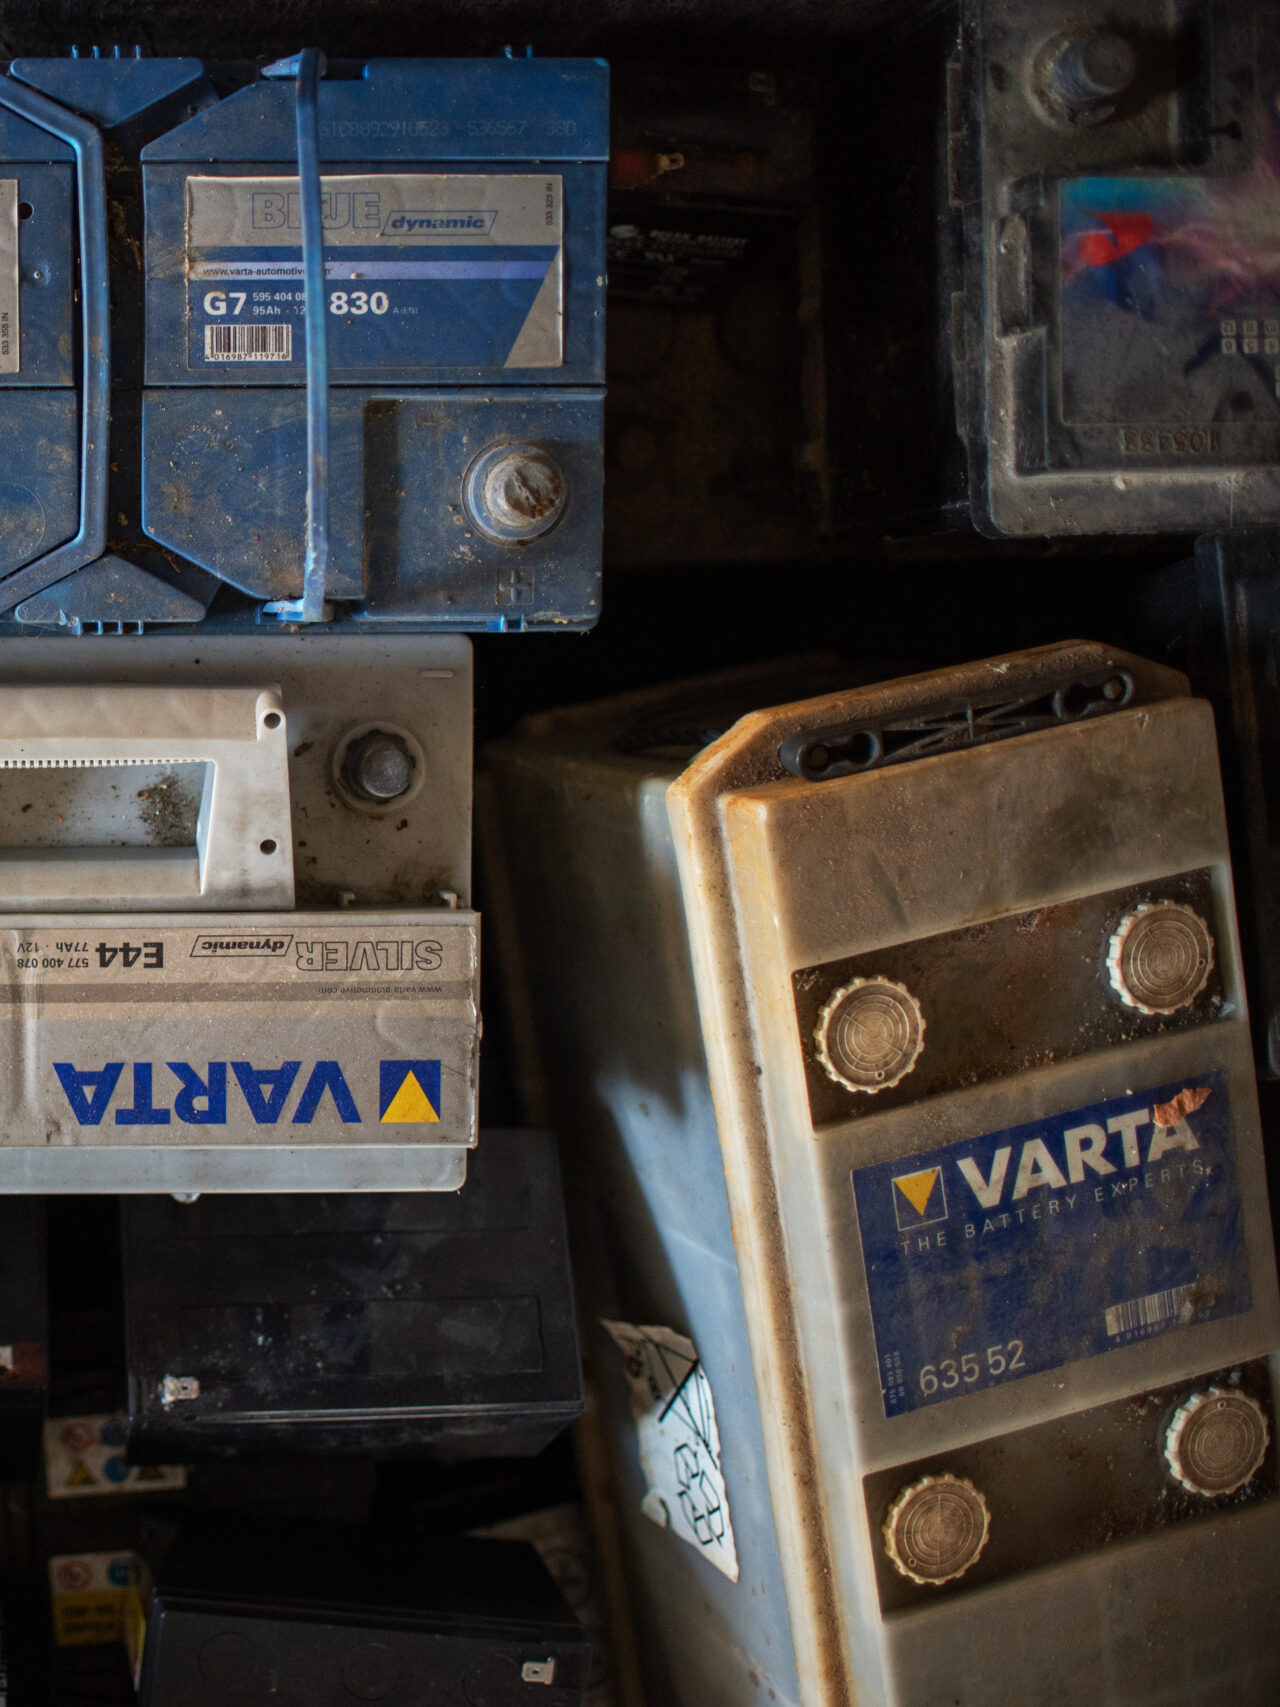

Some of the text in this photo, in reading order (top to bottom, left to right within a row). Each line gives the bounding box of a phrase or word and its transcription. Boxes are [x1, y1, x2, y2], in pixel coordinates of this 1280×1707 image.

[391, 215, 485, 235] dynamic
[203, 290, 248, 316] G7
[252, 292, 271, 302] 595
[273, 292, 293, 302] 404
[329, 290, 390, 316] 830
[252, 305, 281, 316] 95Ah
[17, 942, 40, 953] 12V
[56, 941, 89, 953] 77Ah
[95, 942, 165, 969] E44
[201, 937, 286, 954] dynamic
[295, 940, 444, 972] SILVER
[17, 957, 90, 969] 577 400 078
[318, 985, 444, 995] www.vartaautomotive.com
[51, 1060, 363, 1126] VARTA
[956, 1107, 1200, 1209] VARTA
[899, 1159, 1205, 1256] THE BATTERY EXPERTS
[919, 1339, 1027, 1395] 635 52
